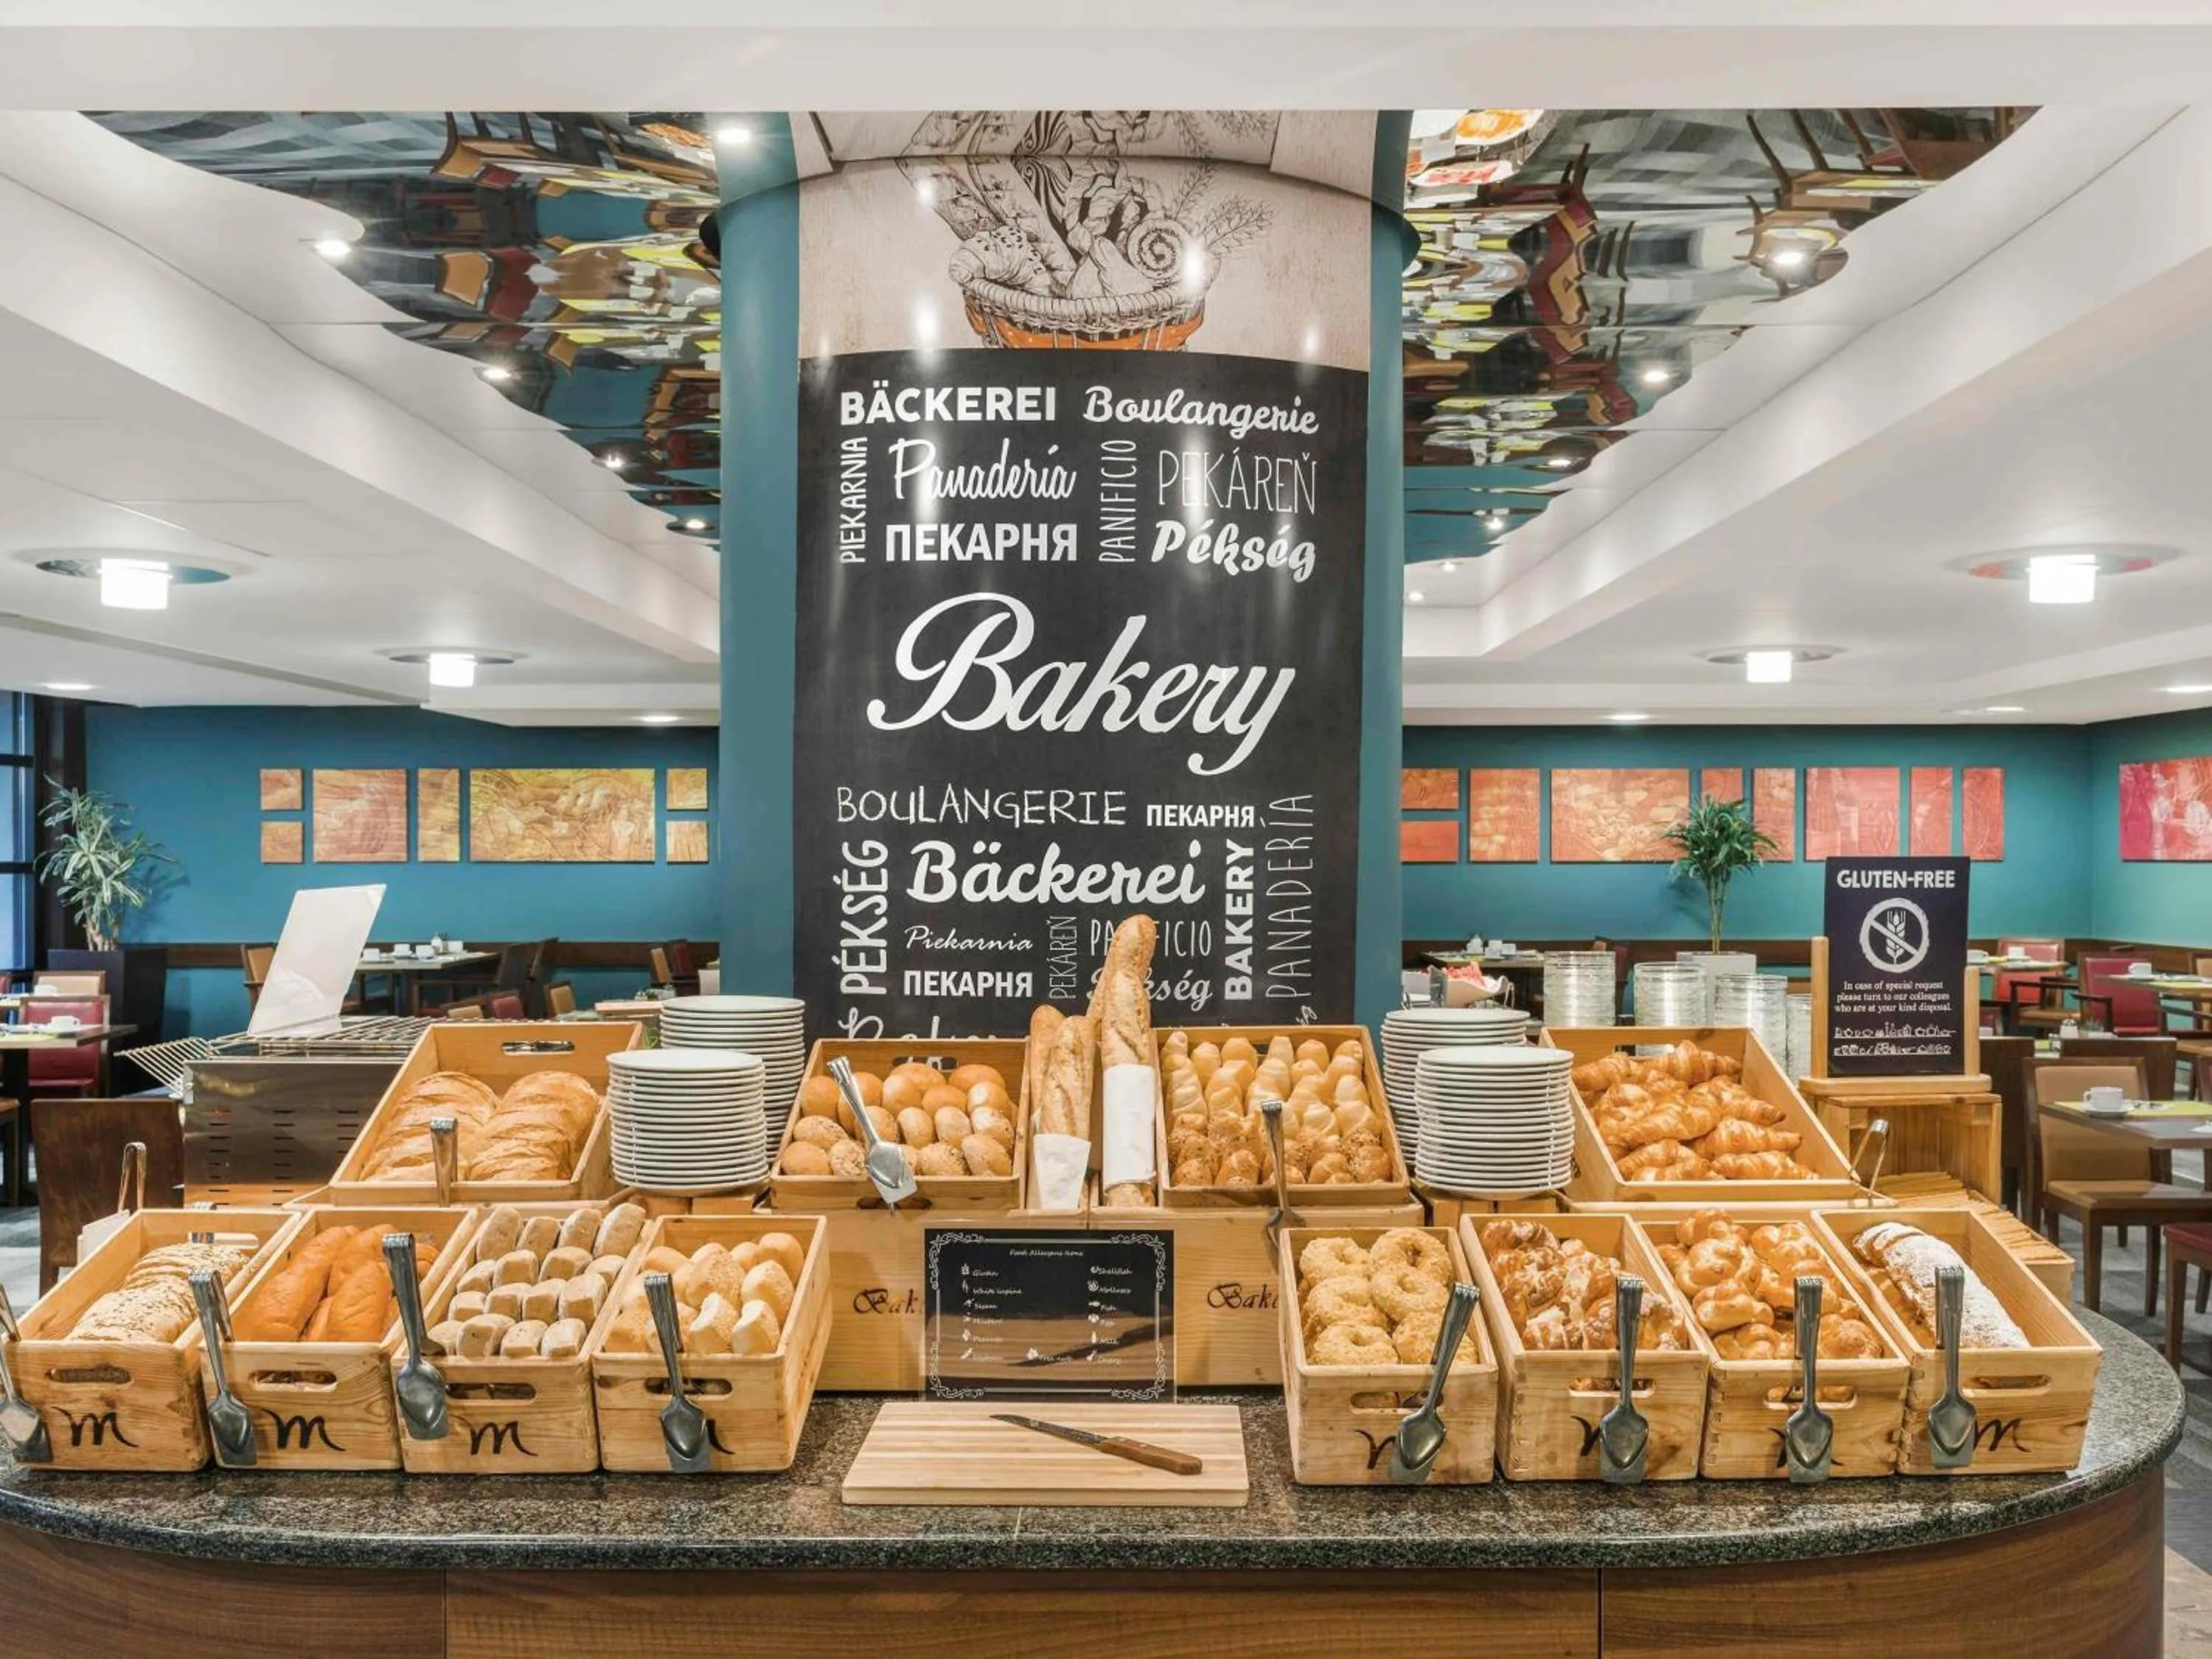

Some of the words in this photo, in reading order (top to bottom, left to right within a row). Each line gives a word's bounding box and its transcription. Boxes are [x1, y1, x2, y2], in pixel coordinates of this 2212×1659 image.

[841, 380, 1056, 425] BÄCKEREI
[1082, 385, 1319, 440] Boulangerie
[888, 437, 1077, 500] Panadería
[1158, 446, 1318, 515] PEKÁREŇ
[839, 436, 868, 564] PIEKARNIA
[1098, 439, 1137, 563] PANIFICIO
[886, 523, 1077, 562] ПЕКАРНЯ
[1150, 518, 1316, 583] Pékség
[866, 591, 1296, 776] Bakery
[837, 782, 1127, 827] BOULANGERIE
[1147, 804, 1255, 828] ПЕКАРНЯ
[905, 838, 1206, 905] Bäckerei
[1837, 869, 1956, 888] GLUTEN-FREE
[831, 839, 888, 995] PÉKSÉG
[1259, 793, 1313, 998] PANADERÍA
[904, 925, 1033, 951] Piekarnia
[1091, 919, 1212, 957] PAICIO
[1224, 838, 1253, 1000] BAKERY
[1046, 915, 1077, 999] PEKÁREŇ
[903, 970, 1033, 998] ПЕКАРНЯ
[1086, 967, 1213, 1012] kség
[1837, 992, 1862, 1003] please
[1909, 992, 1950, 1002] colleagues
[1843, 981, 1853, 990] In
[1874, 981, 1884, 990] of
[1885, 981, 1913, 992] special
[1915, 981, 1944, 992] request
[1834, 1003, 1851, 1012] who
[1868, 1004, 1876, 1012] at
[1878, 1004, 1897, 1014] your
[1899, 1003, 1916, 1012] kind
[853, 1288, 920, 1314] Bak
